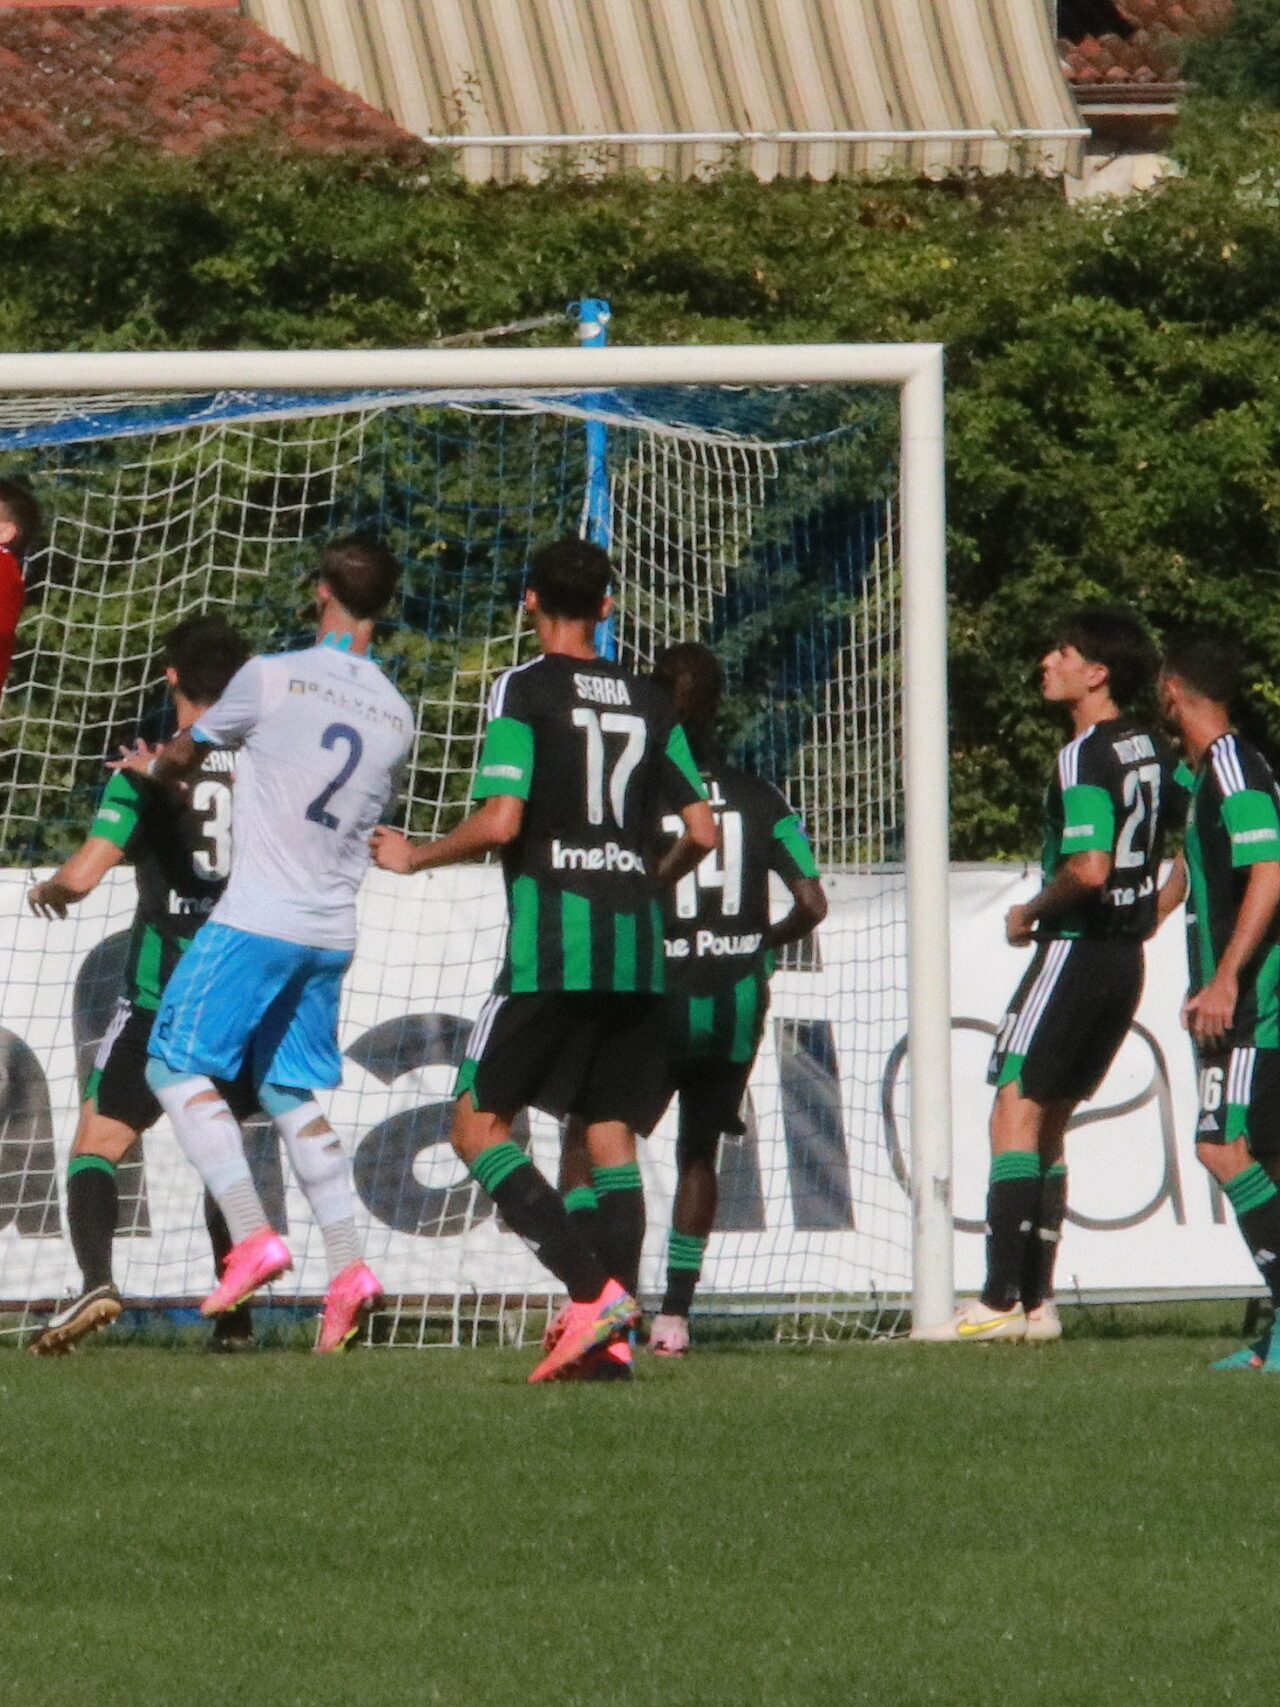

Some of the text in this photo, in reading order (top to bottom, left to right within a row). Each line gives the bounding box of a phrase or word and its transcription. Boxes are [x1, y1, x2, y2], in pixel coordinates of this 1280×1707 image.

[573, 672, 632, 706] SERRA
[304, 722, 363, 832] 2
[572, 707, 648, 829] 17
[193, 780, 232, 881] 3
